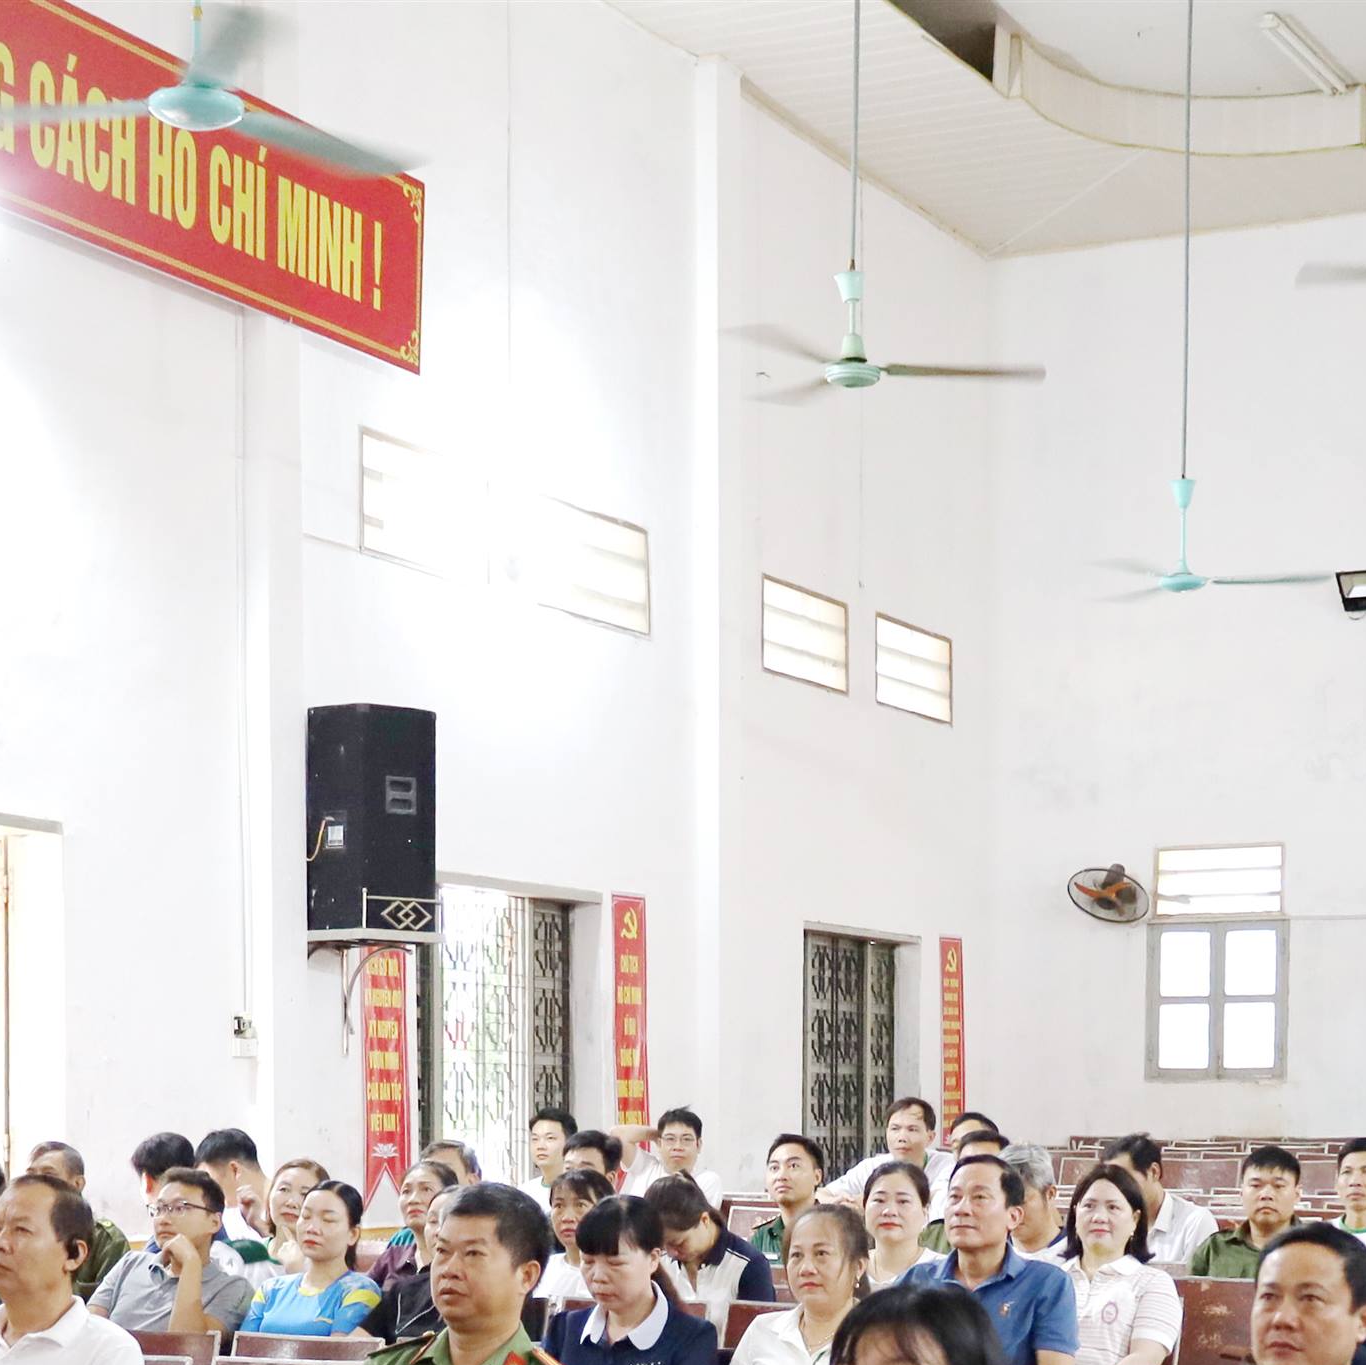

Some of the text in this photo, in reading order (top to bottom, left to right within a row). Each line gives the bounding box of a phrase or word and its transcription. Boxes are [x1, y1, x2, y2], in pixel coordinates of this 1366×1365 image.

[29, 52, 136, 202] CÁCH
[209, 144, 268, 262] CHÍ
[277, 175, 363, 303] MINH
[372, 220, 382, 311] !
